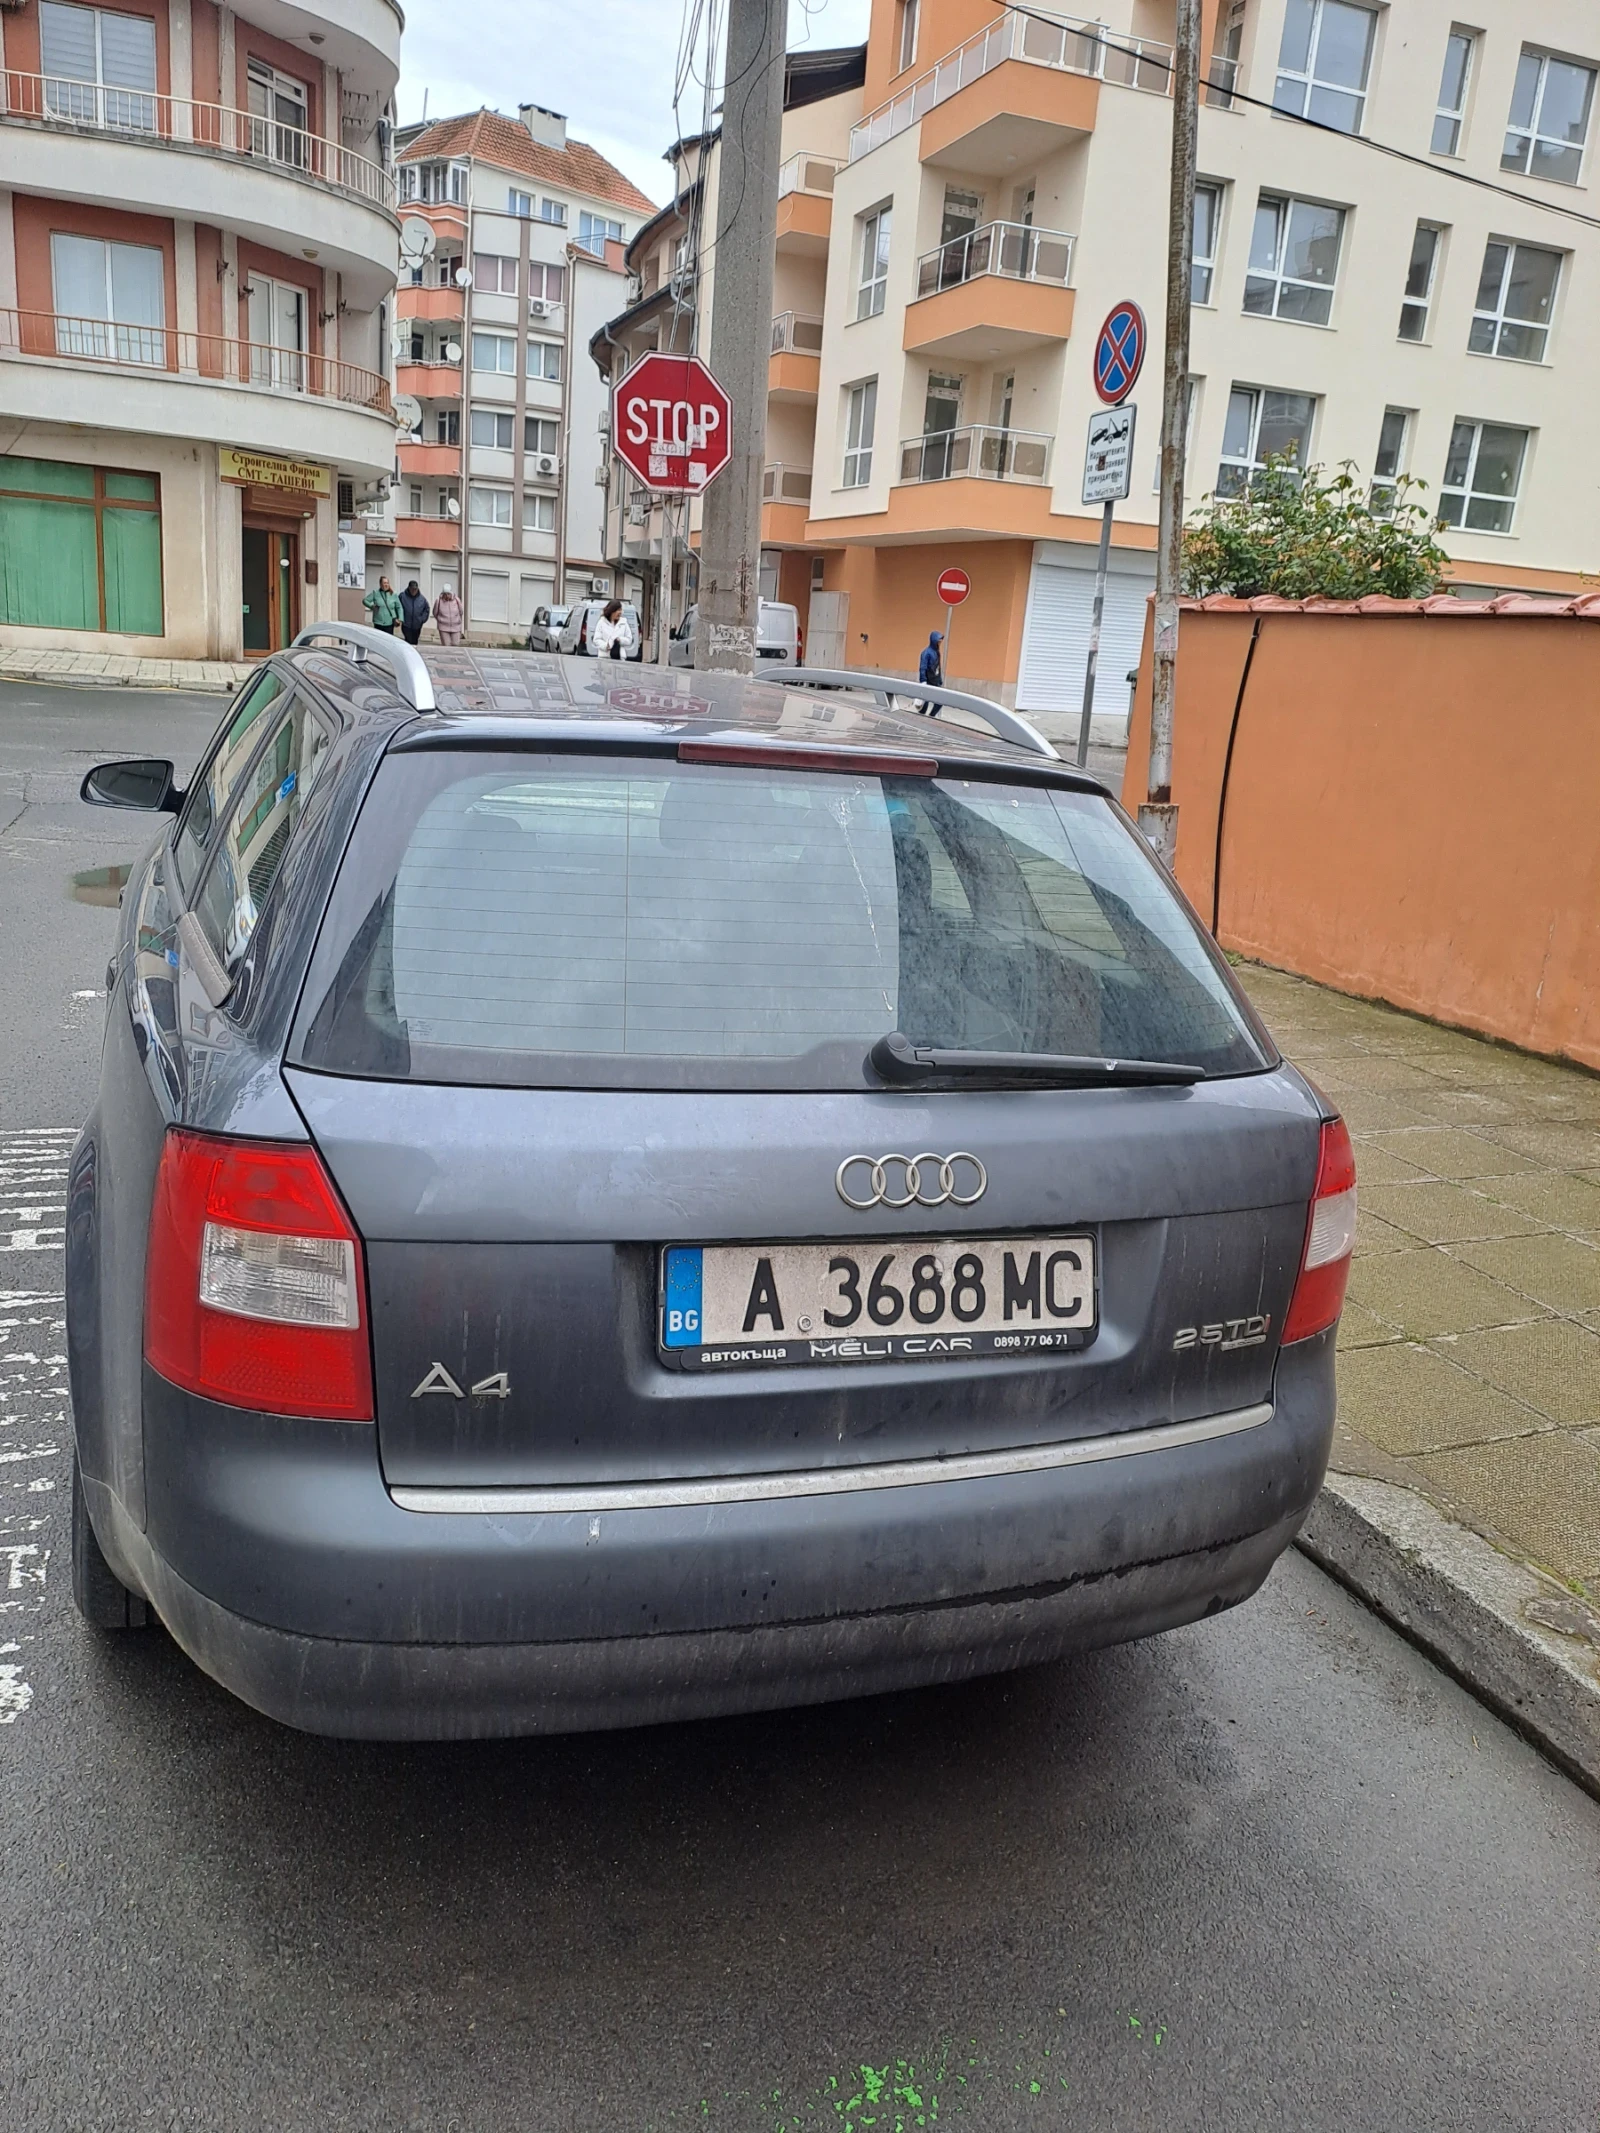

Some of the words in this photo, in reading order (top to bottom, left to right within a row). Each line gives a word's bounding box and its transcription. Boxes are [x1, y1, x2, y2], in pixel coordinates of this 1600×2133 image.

[626, 396, 720, 450] STOP
[232, 452, 287, 472] Строителна
[289, 463, 320, 478] Фирма
[238, 467, 262, 481] СМТ
[270, 472, 315, 489] ТАШЕВИ
[742, 1257, 785, 1332] A
[823, 1254, 986, 1328] 3688
[1003, 1250, 1082, 1321] MC
[669, 1309, 699, 1332] BG
[810, 1341, 892, 1358] MELI
[903, 1337, 972, 1353] CAR
[994, 1336, 1021, 1348] 0898
[1023, 1335, 1037, 1347] 77
[1039, 1335, 1053, 1346] 06
[1055, 1334, 1068, 1345] 71
[701, 1347, 787, 1364] автокъща
[410, 1361, 512, 1399] A4
